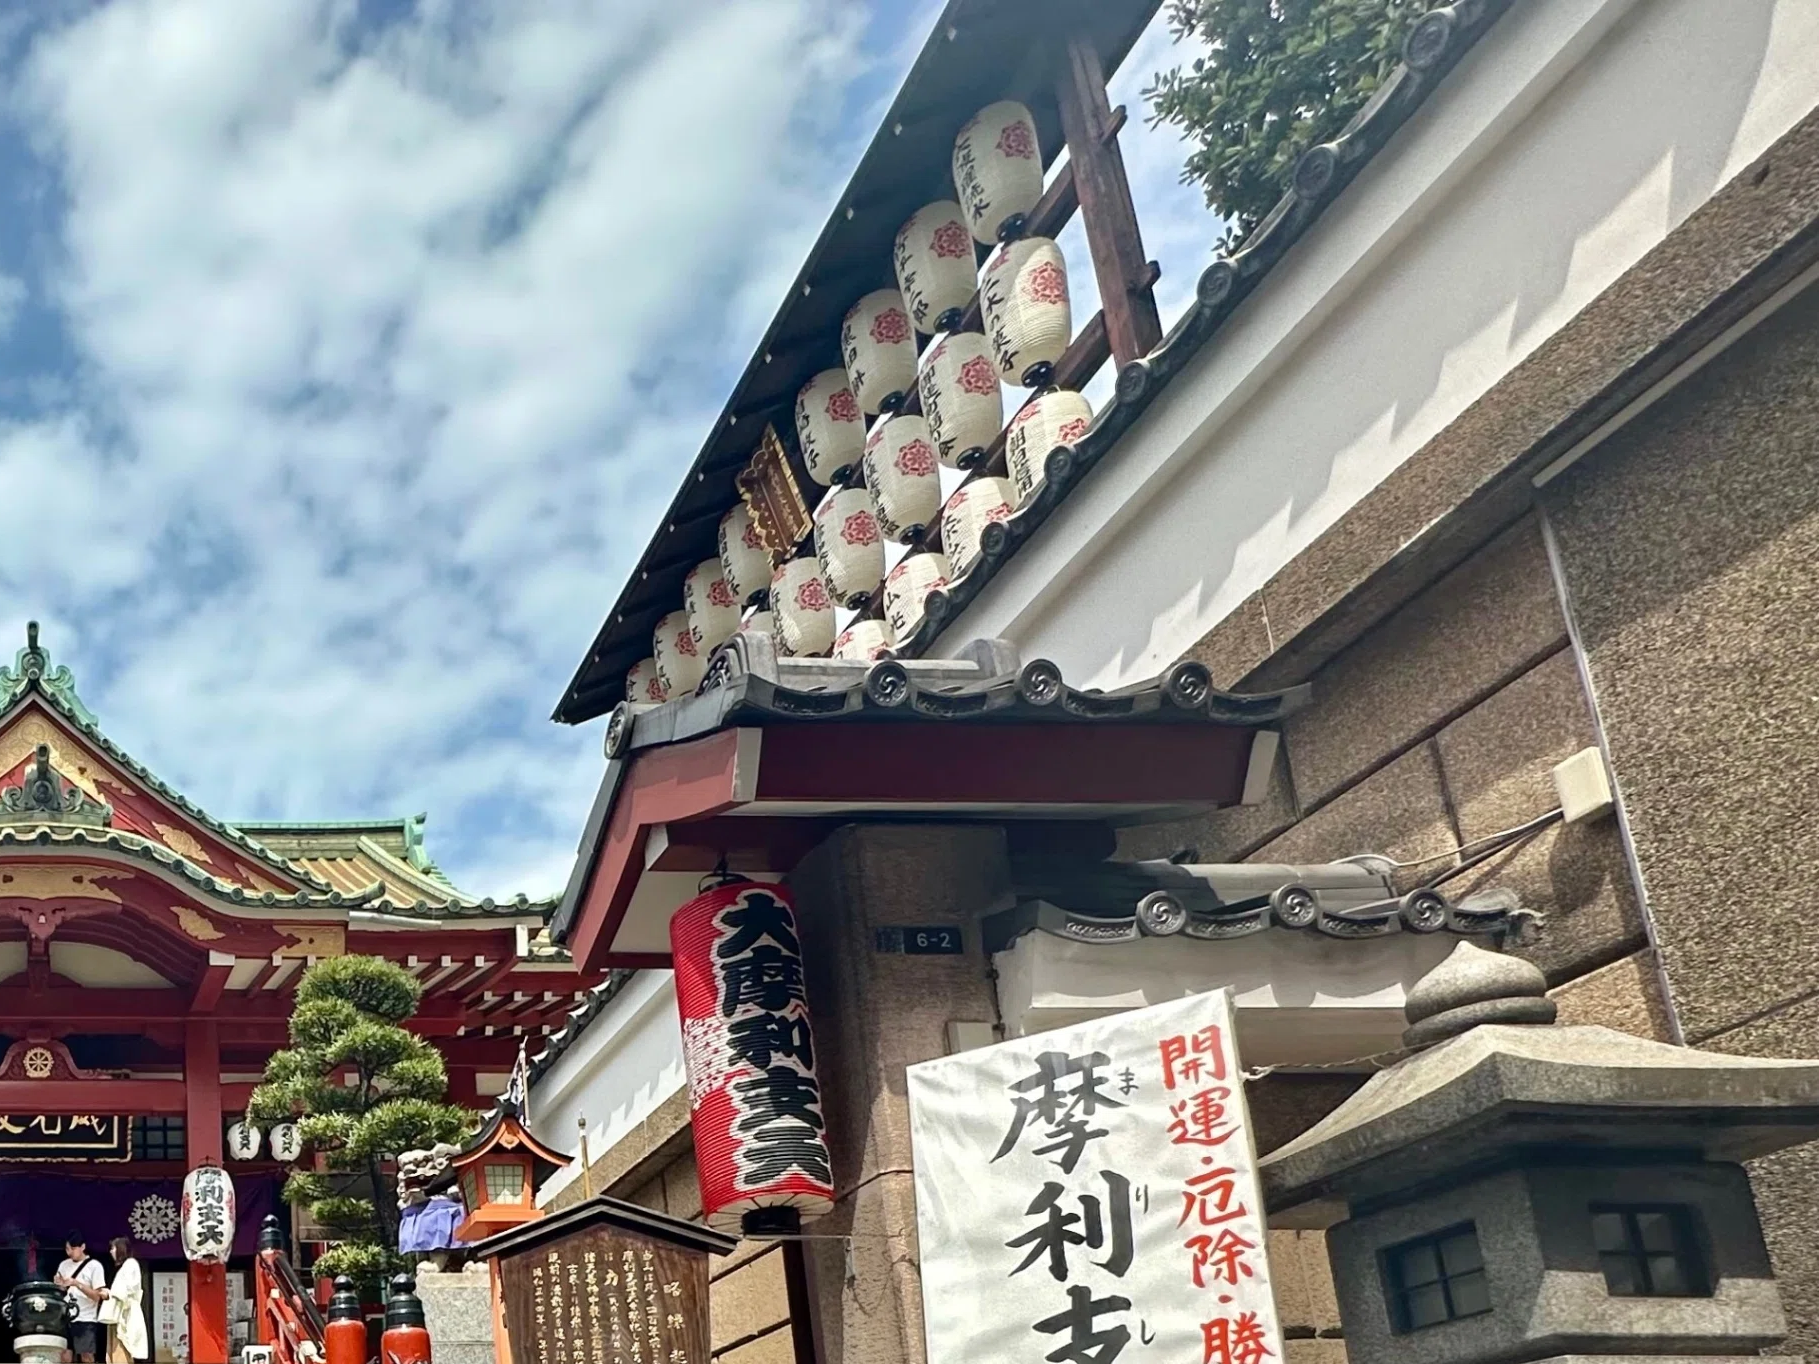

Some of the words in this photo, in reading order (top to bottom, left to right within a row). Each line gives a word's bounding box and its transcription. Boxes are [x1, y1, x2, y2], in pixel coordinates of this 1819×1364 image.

[917, 932, 951, 948] 6-2
[195, 1169, 225, 1246] 摩利支天
